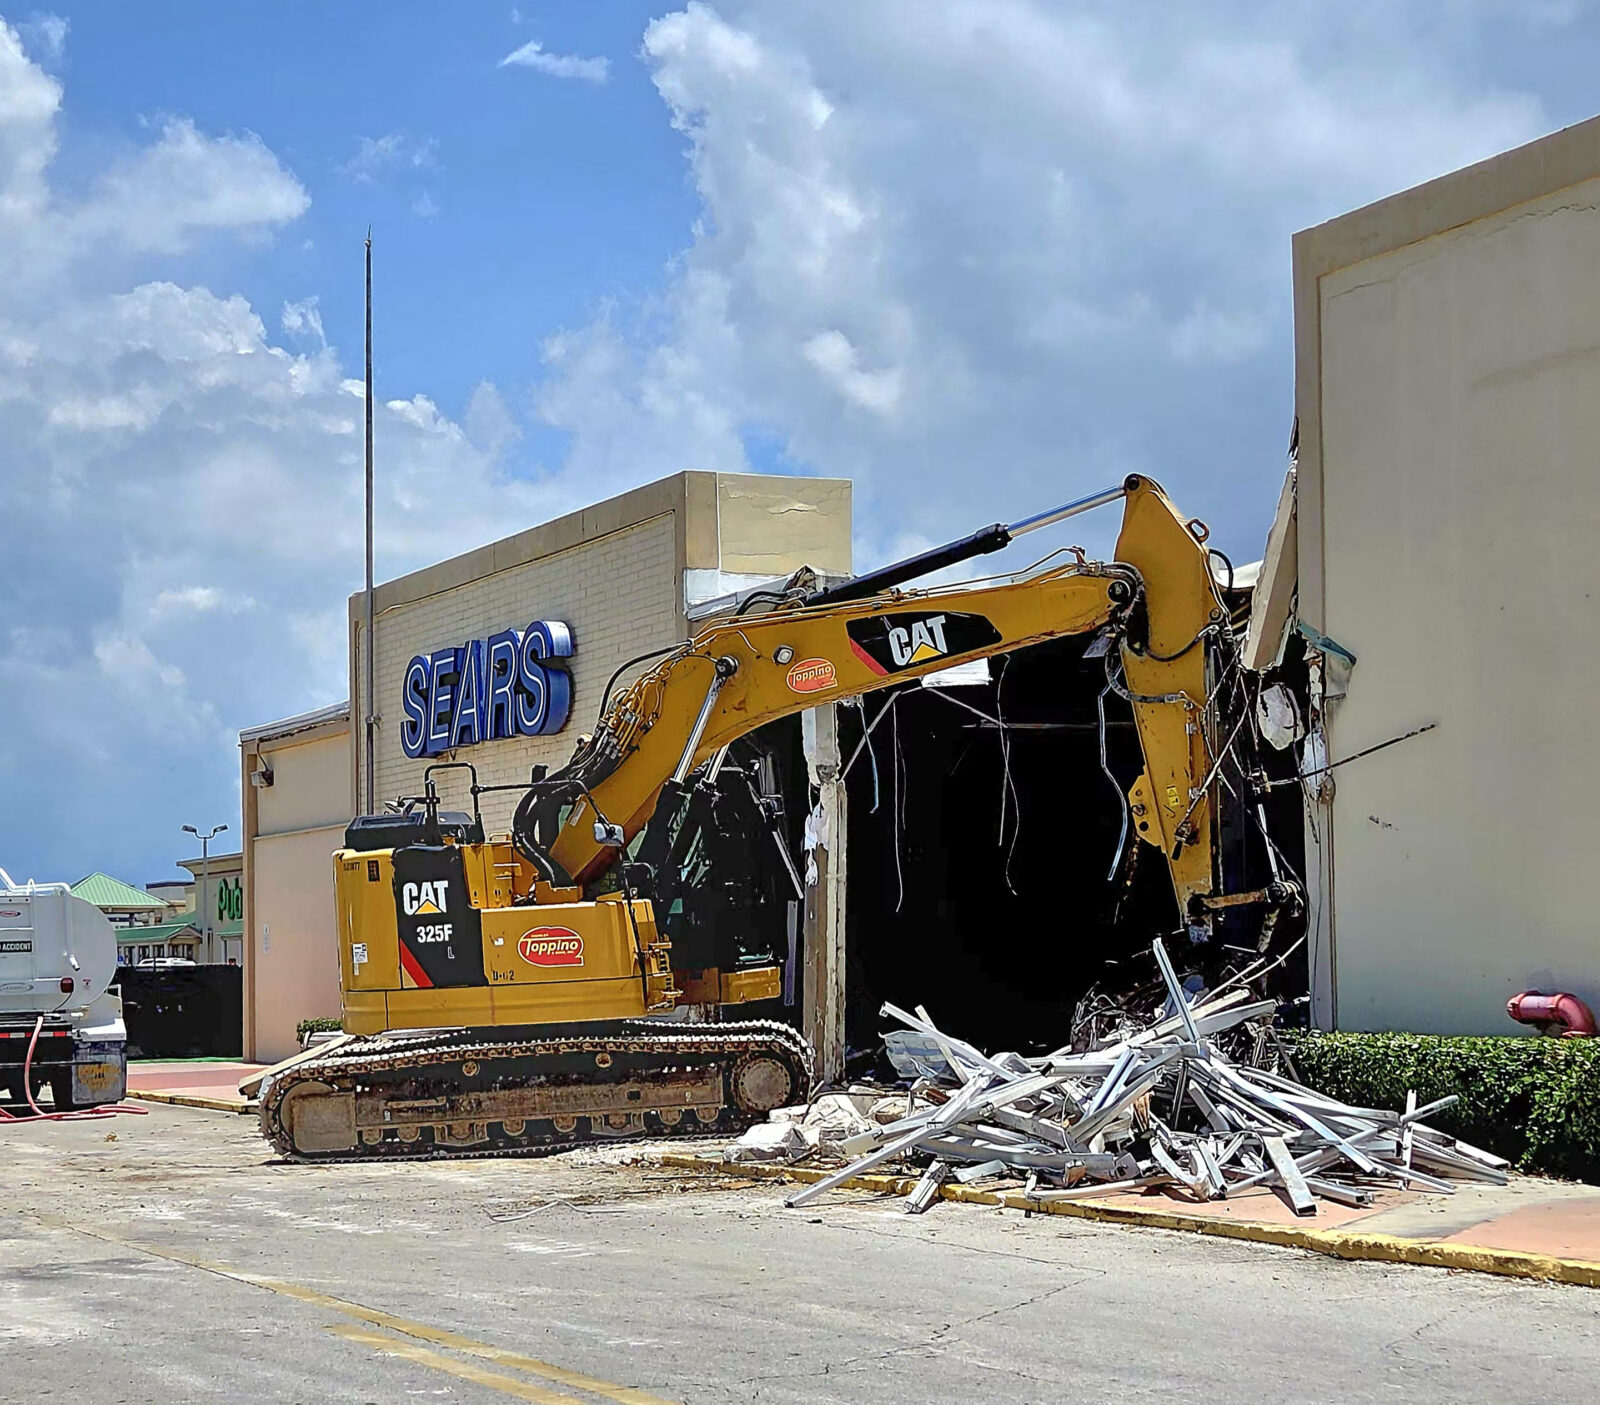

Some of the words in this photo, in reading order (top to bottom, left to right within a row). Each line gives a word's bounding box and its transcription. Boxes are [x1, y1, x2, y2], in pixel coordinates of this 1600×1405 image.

[888, 614, 948, 666] CAT
[790, 663, 831, 687] Toppino
[401, 620, 574, 759] SEARS
[402, 880, 449, 915] CAT
[416, 924, 453, 943] 325F
[2, 942, 31, 951] ACCIDENT
[522, 938, 579, 957] Toppino
